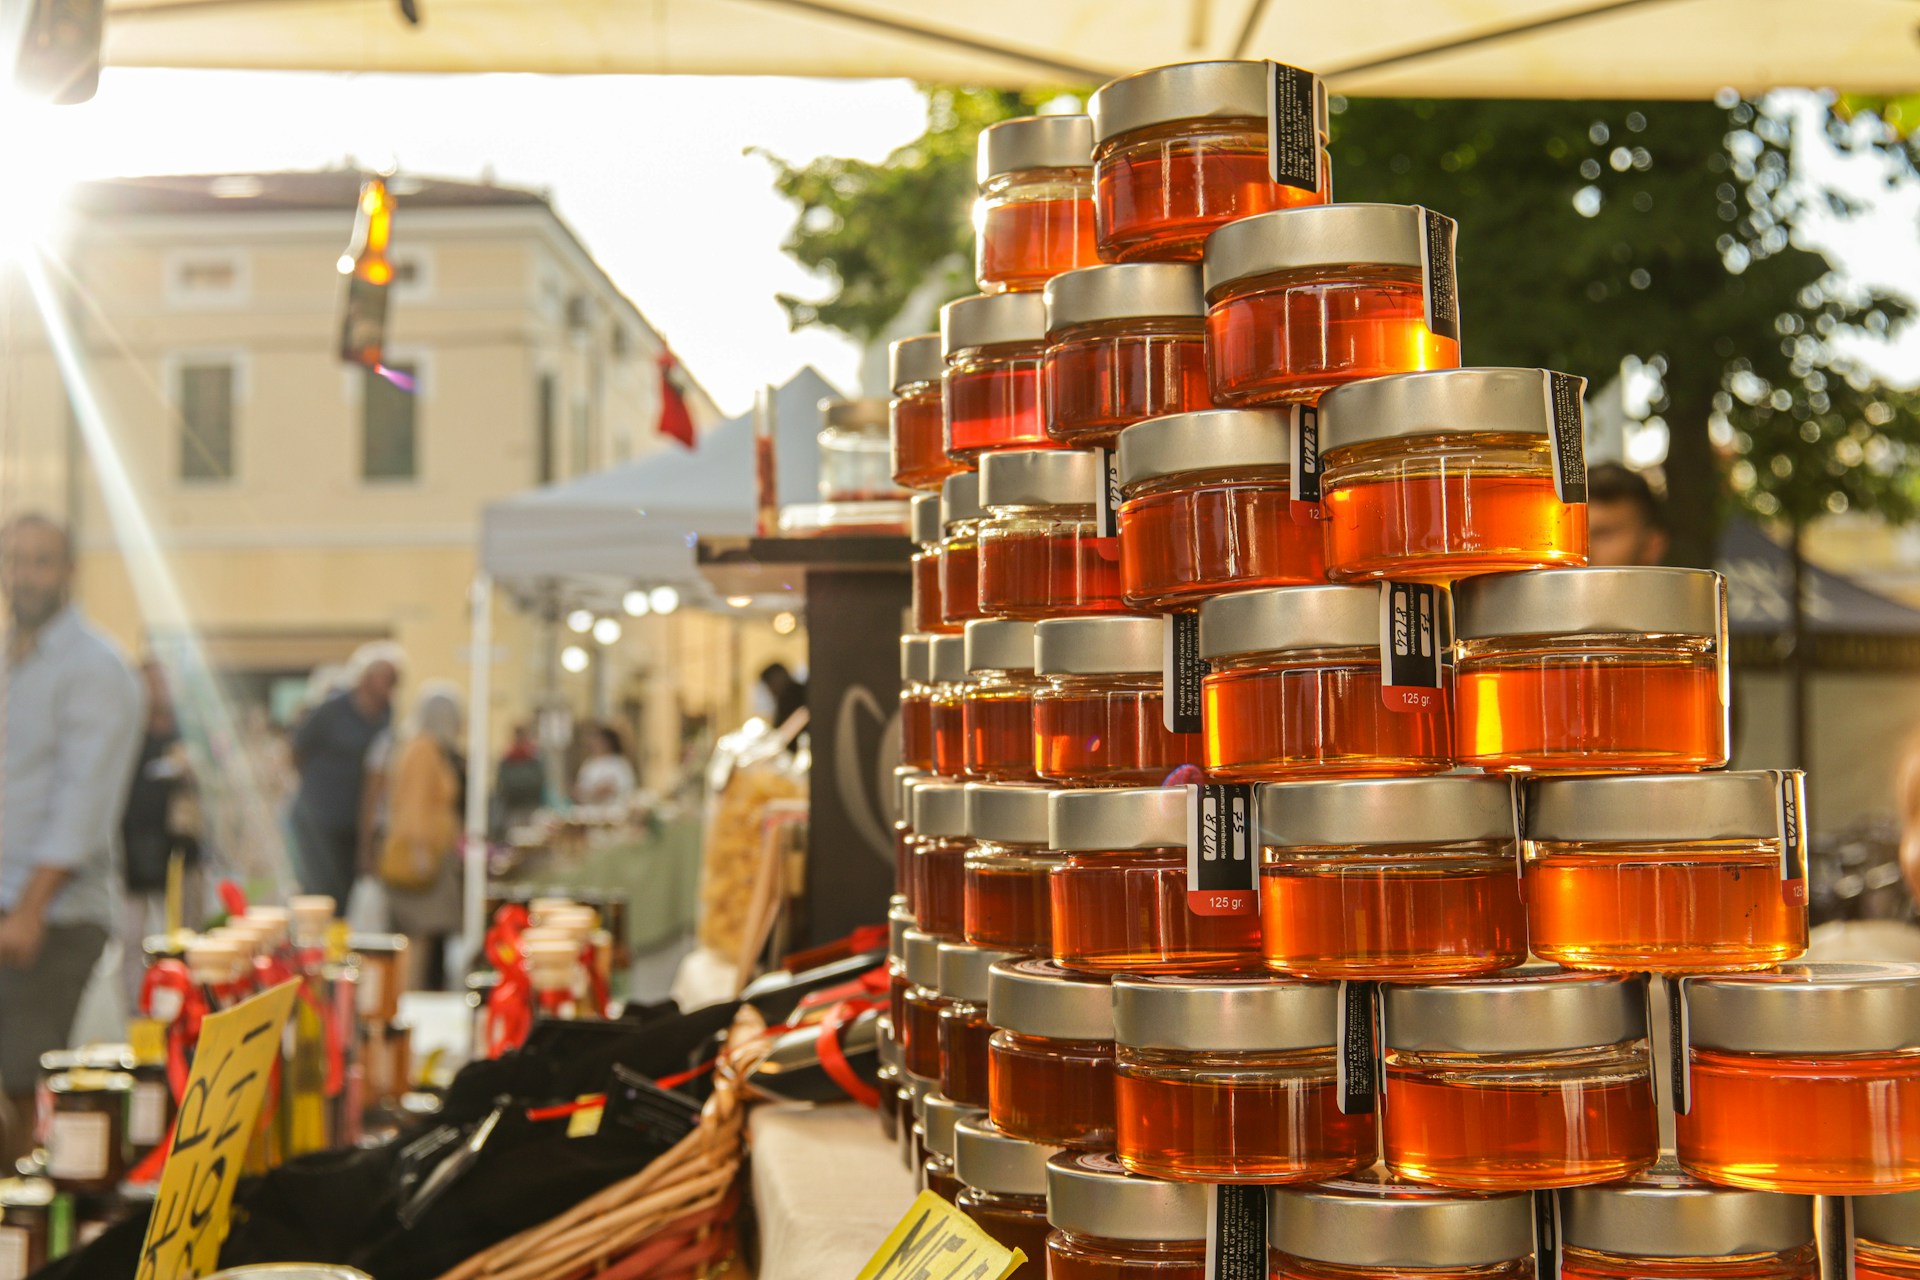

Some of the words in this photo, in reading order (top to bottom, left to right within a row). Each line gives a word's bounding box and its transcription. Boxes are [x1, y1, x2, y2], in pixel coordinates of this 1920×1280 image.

[1308, 509, 1320, 519] 12
[1402, 692, 1418, 704] 125
[1210, 897, 1228, 908] 125
